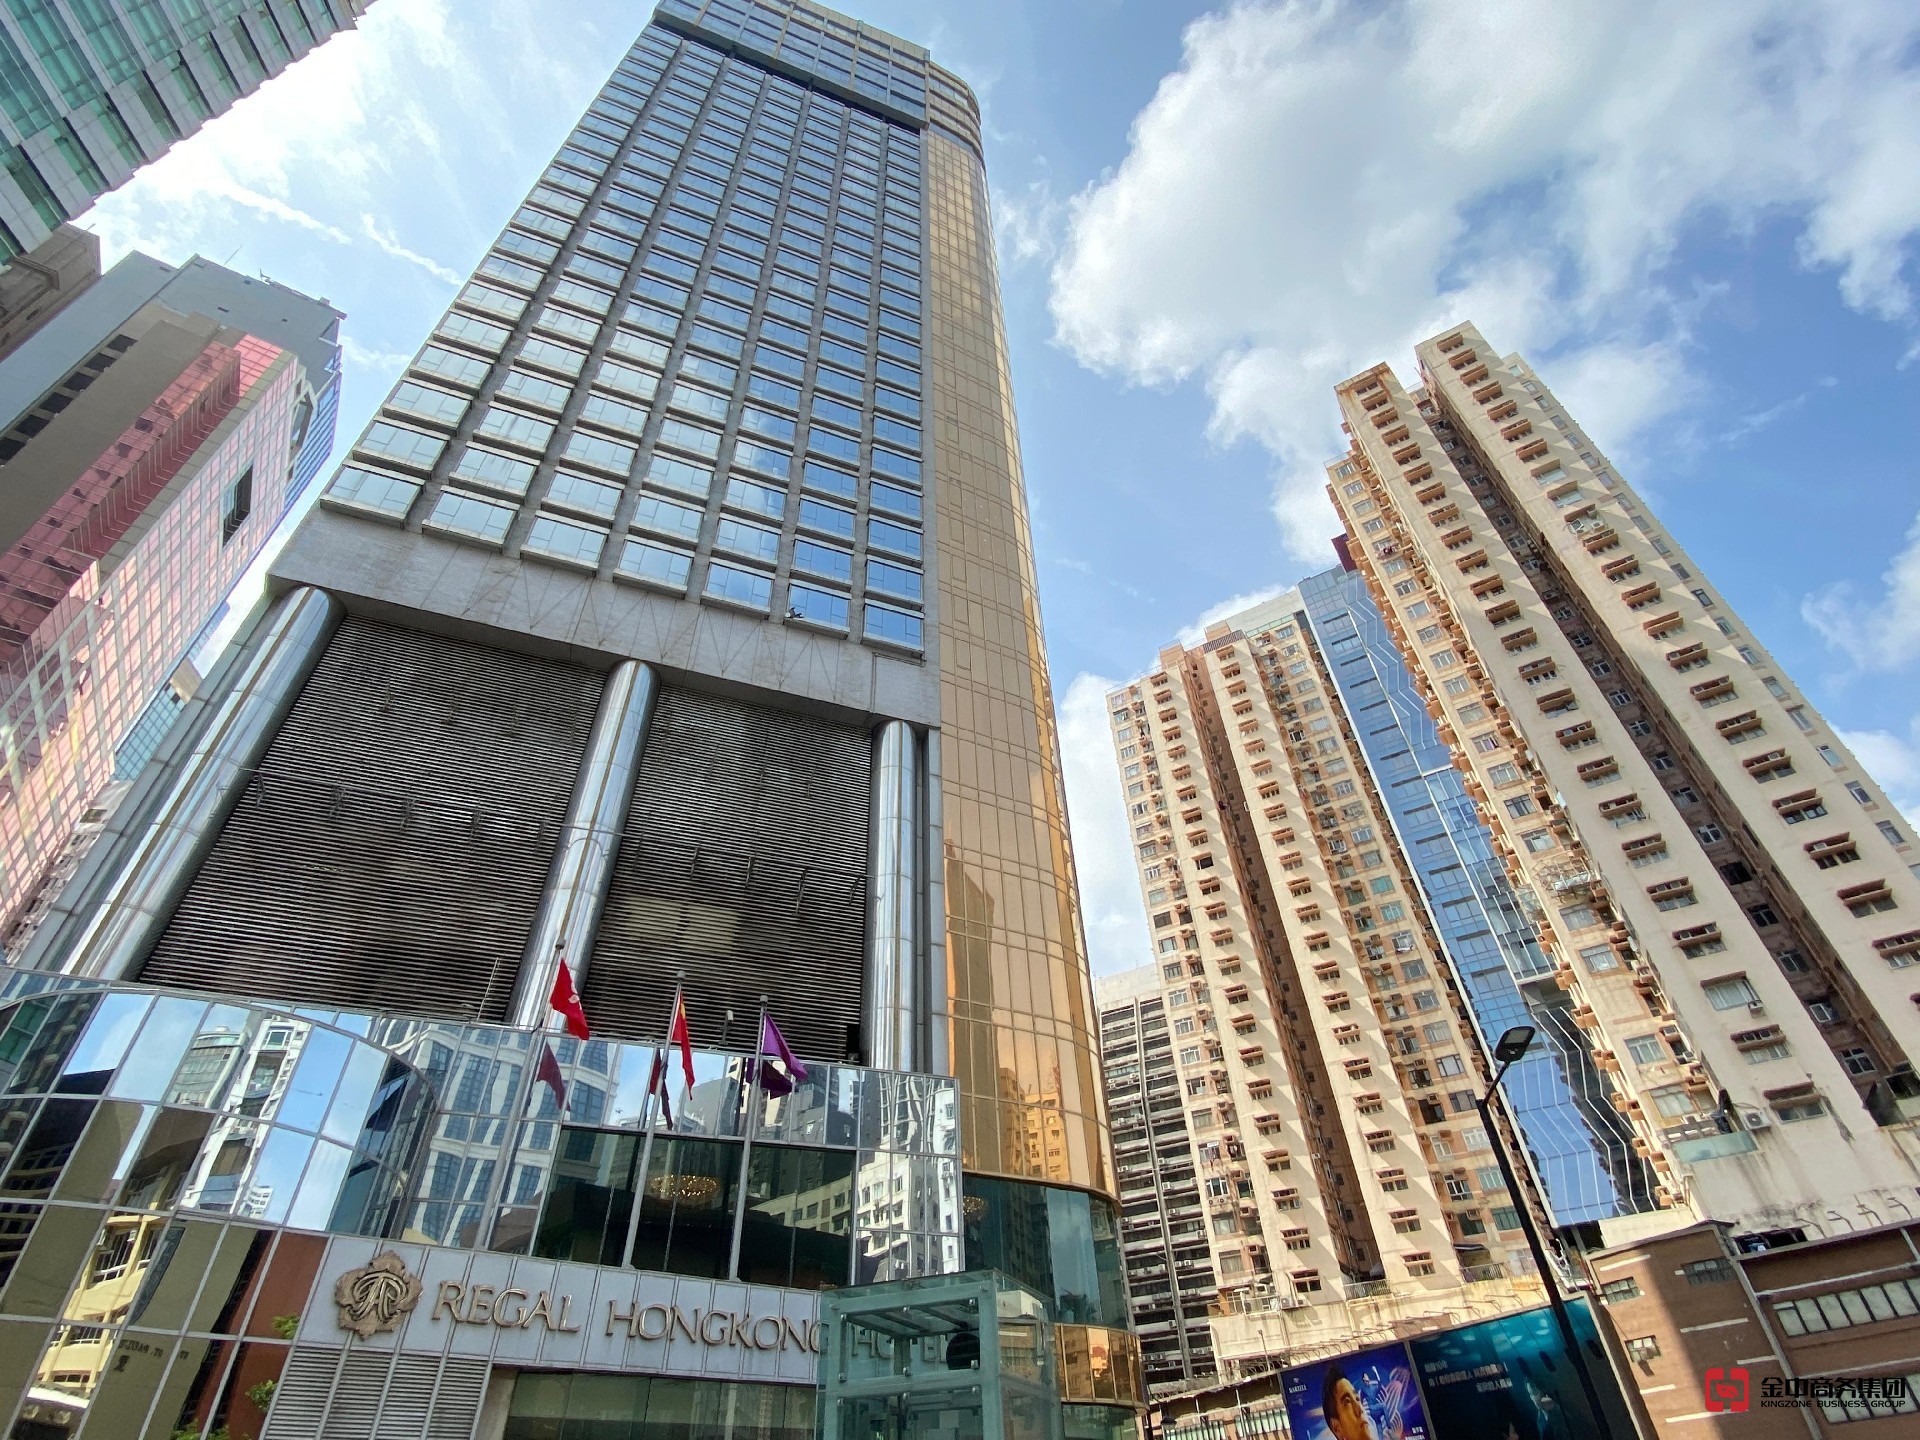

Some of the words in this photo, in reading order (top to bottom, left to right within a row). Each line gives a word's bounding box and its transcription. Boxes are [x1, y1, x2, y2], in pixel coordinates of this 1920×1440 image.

[431, 1280, 580, 1332] REGAL
[605, 1299, 830, 1354] HONGKONG
[852, 1323, 956, 1363] HOE
